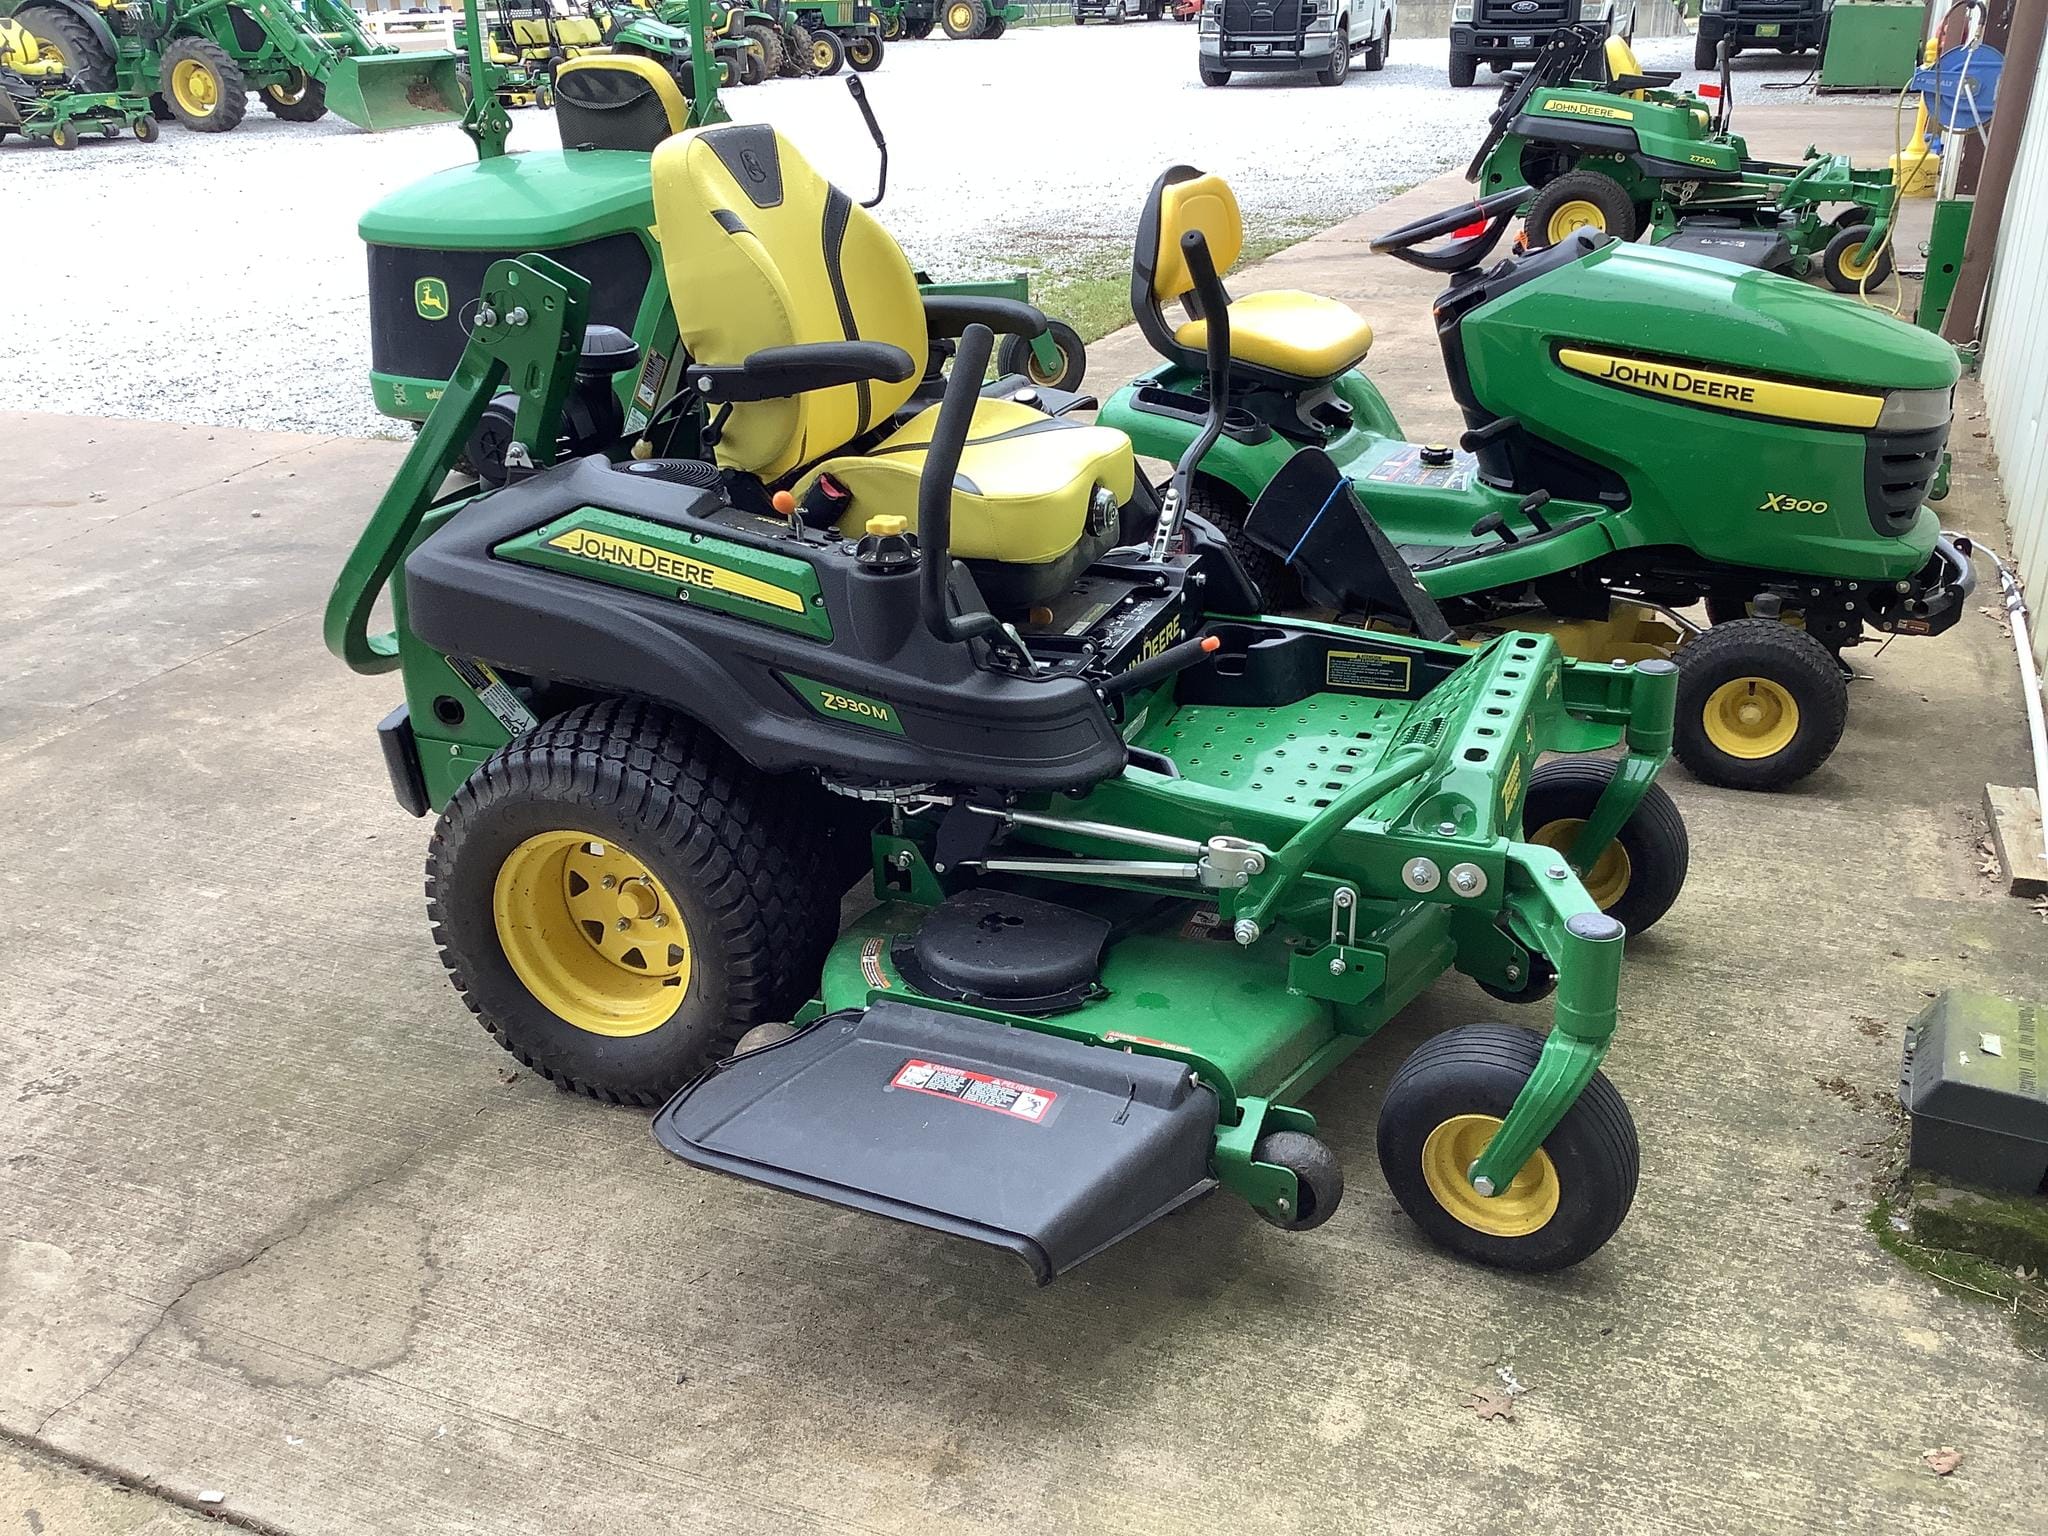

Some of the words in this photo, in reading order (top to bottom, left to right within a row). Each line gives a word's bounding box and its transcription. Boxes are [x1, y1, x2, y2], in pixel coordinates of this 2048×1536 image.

[1550, 101, 1578, 113] JOHN
[1580, 104, 1614, 117] DEERE
[1689, 154, 1718, 166] Z720A
[1601, 361, 1668, 388] JOHN
[1672, 372, 1755, 402] DEERE
[1758, 492, 1828, 514] X300
[571, 533, 633, 566] JOHN
[639, 548, 714, 586] DEERE
[1143, 613, 1180, 661] DEERE
[820, 691, 889, 721] Z930M
[933, 1064, 966, 1077] DANGER
